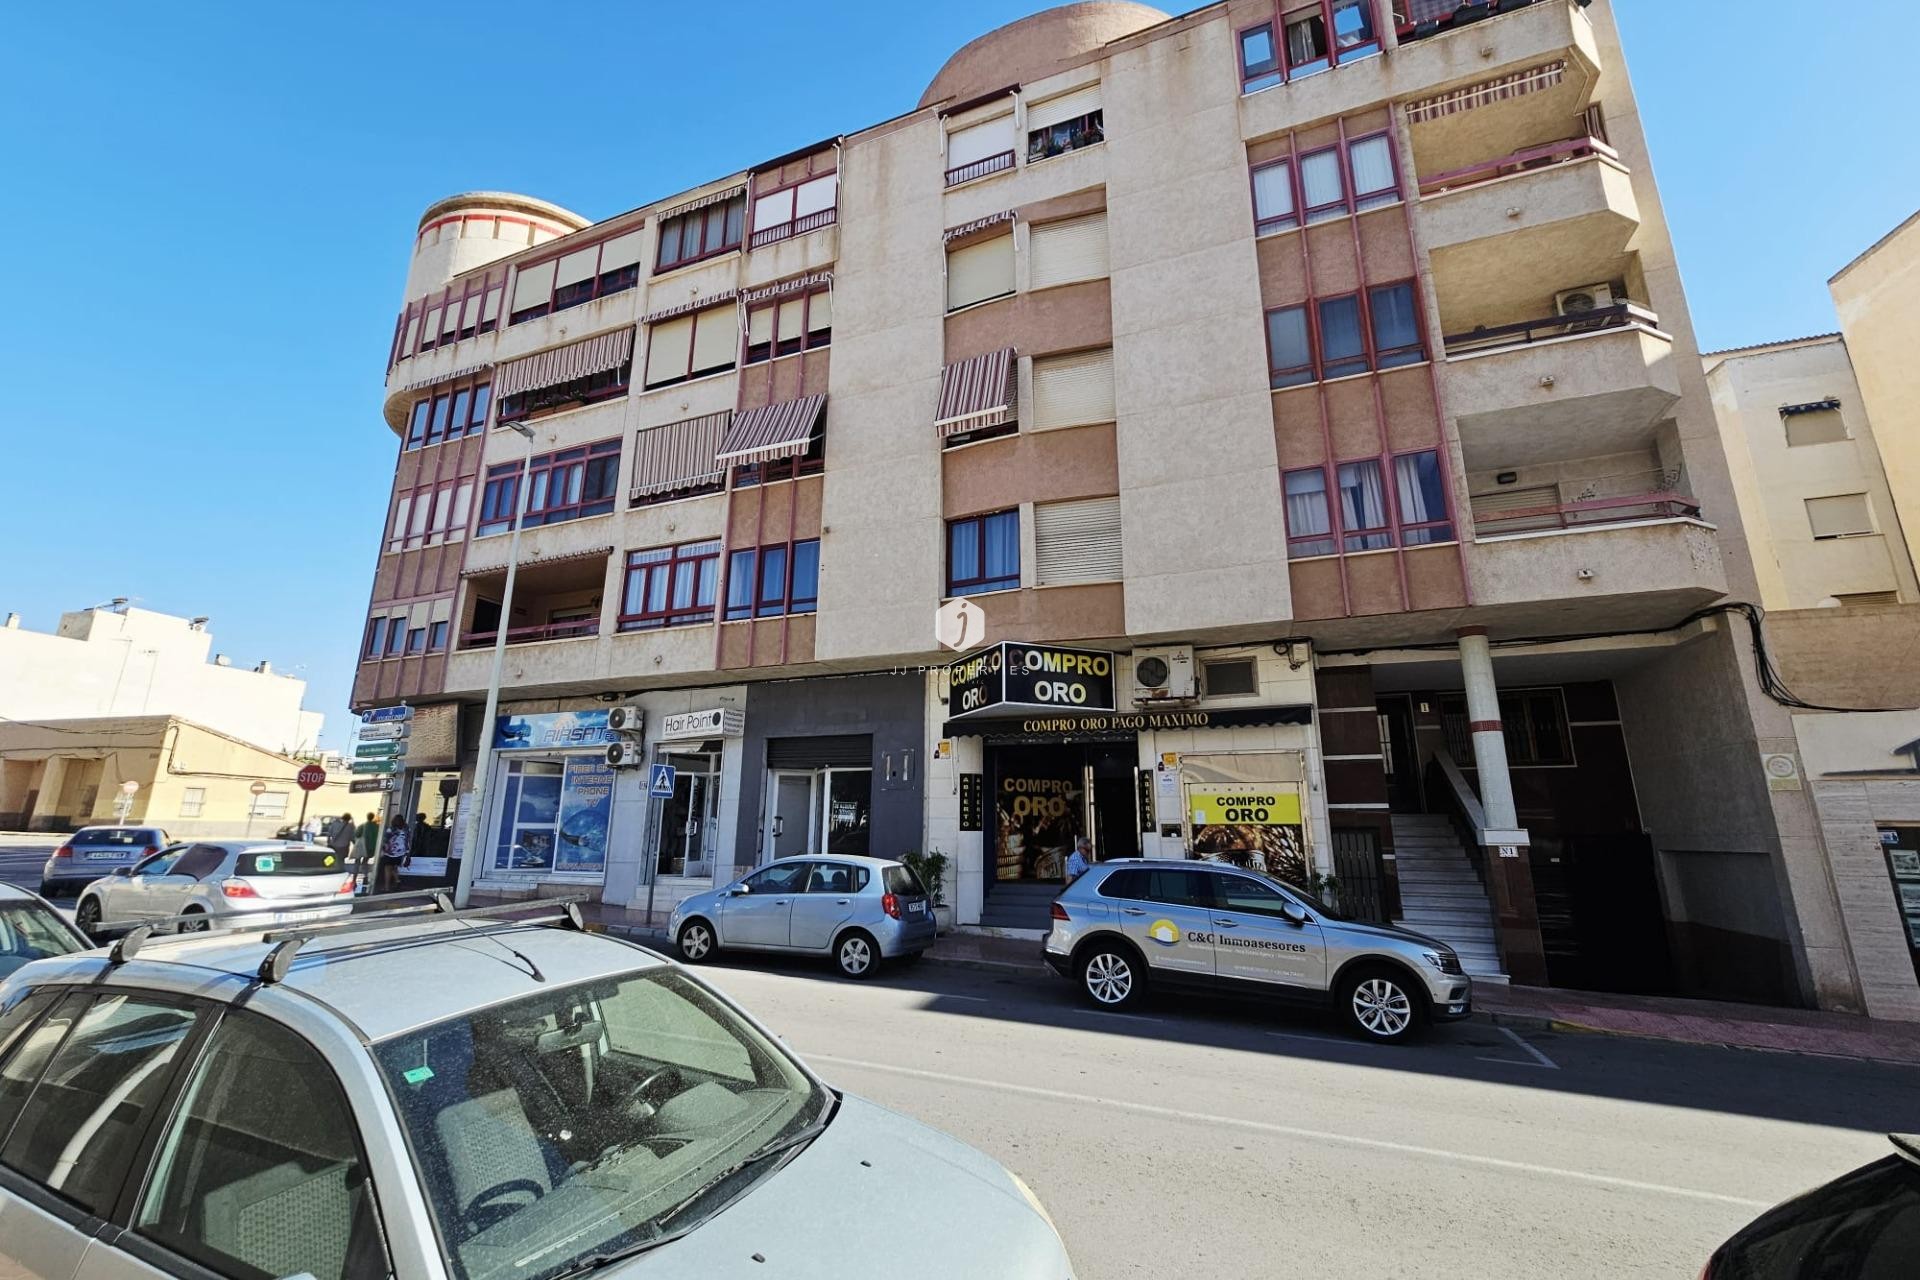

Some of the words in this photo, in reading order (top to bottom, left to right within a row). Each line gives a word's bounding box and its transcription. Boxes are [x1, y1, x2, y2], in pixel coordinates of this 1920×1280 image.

[951, 651, 1002, 687] COMPRO
[1008, 650, 1109, 677] COMPRO
[962, 684, 988, 711] ORO
[1034, 680, 1087, 704] ORO
[665, 715, 686, 732] Hair
[687, 712, 712, 730] Point
[1024, 718, 1076, 732] COMPRO
[1080, 717, 1107, 731] ORO
[1112, 715, 1145, 729] PAGO
[1150, 713, 1209, 727] MAXIMO
[300, 771, 325, 783] STOP
[1003, 778, 1073, 793] COMPRO
[1013, 795, 1066, 817] ORO
[1216, 796, 1276, 807] COMPRO
[1225, 808, 1269, 822] ORO
[1187, 931, 1215, 944] C&C
[1219, 934, 1306, 953] Inmoasesores
